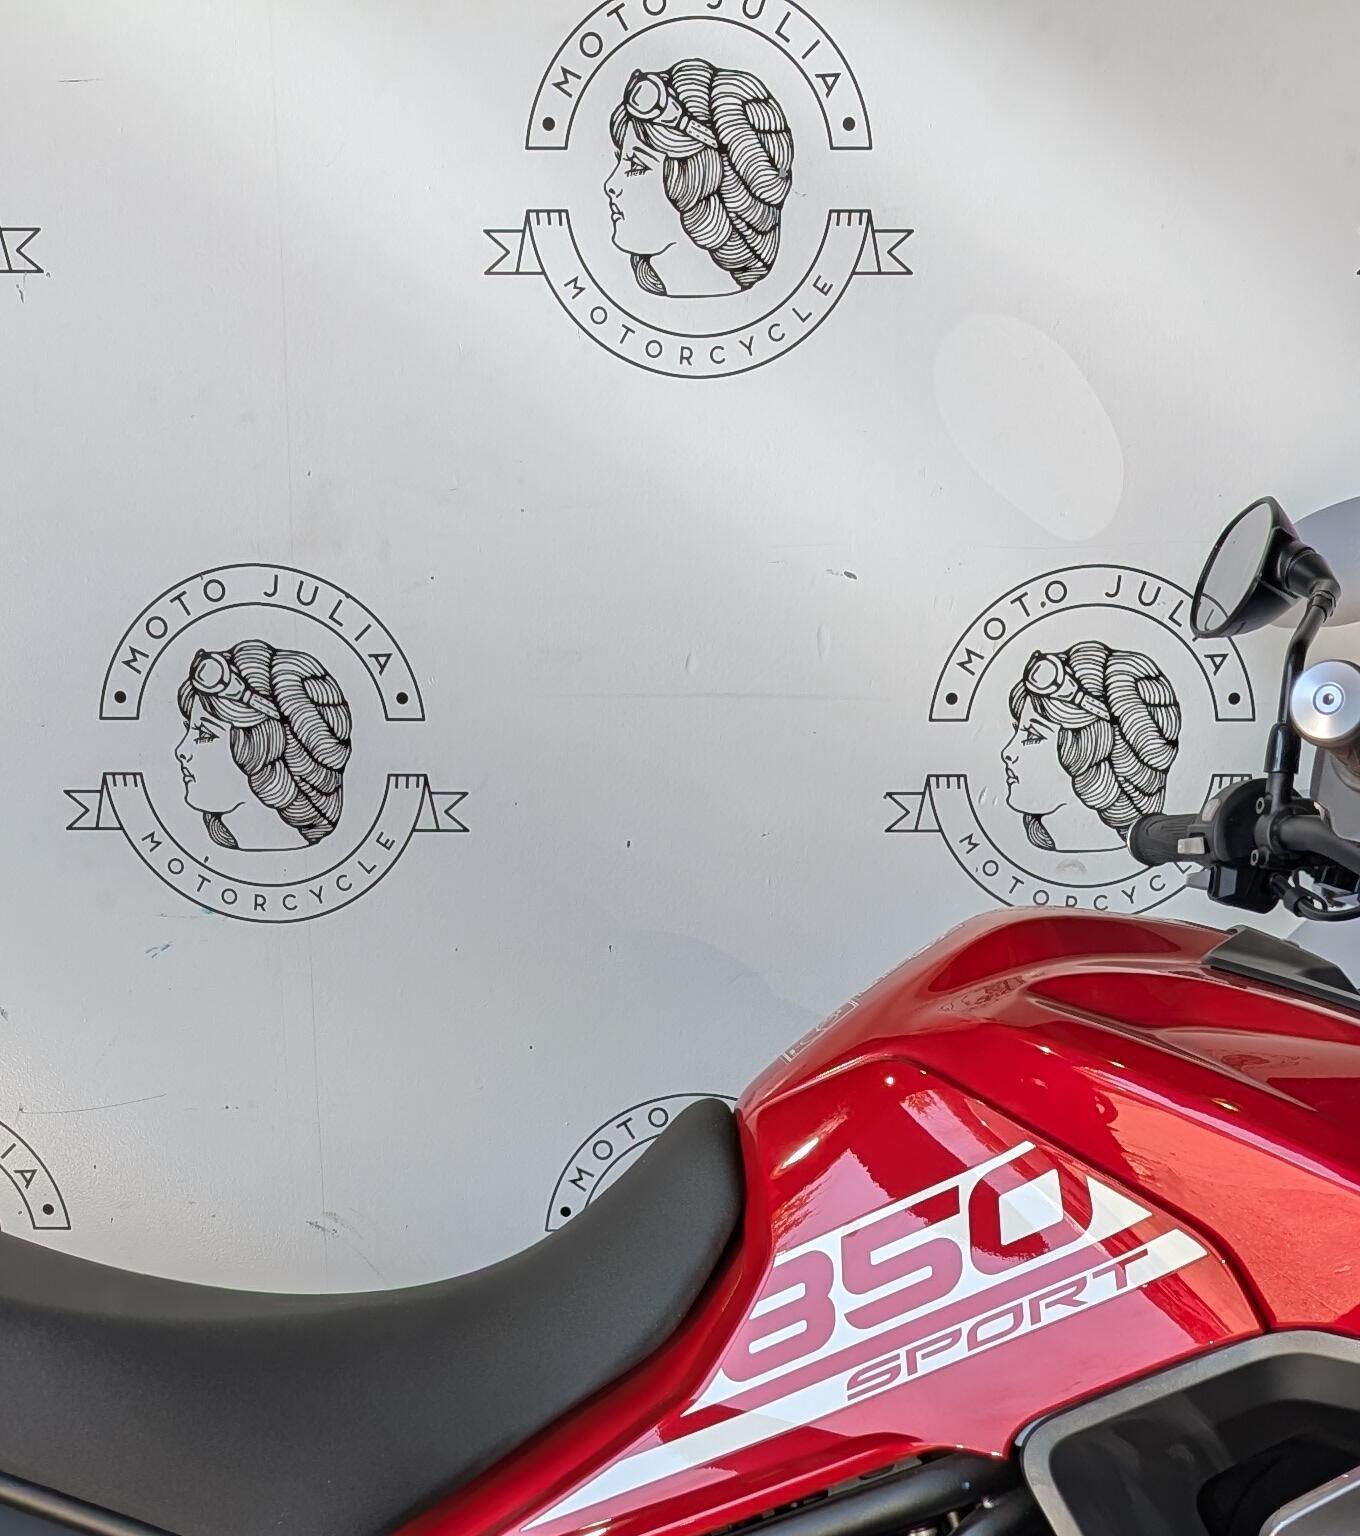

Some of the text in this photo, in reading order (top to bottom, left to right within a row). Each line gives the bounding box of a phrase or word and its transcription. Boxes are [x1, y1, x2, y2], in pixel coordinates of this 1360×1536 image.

[563, 273, 835, 366] MOTORCYCLE
[124, 574, 392, 676] MOTO JULIA
[956, 575, 1229, 676] MOTO JULA
[141, 830, 396, 912] MOTORCYCLE
[959, 832, 1192, 910] MOTORCYCL
[568, 1107, 669, 1192] MOTO
[721, 1164, 1094, 1382] 850
[847, 1249, 1149, 1400] SPORT
